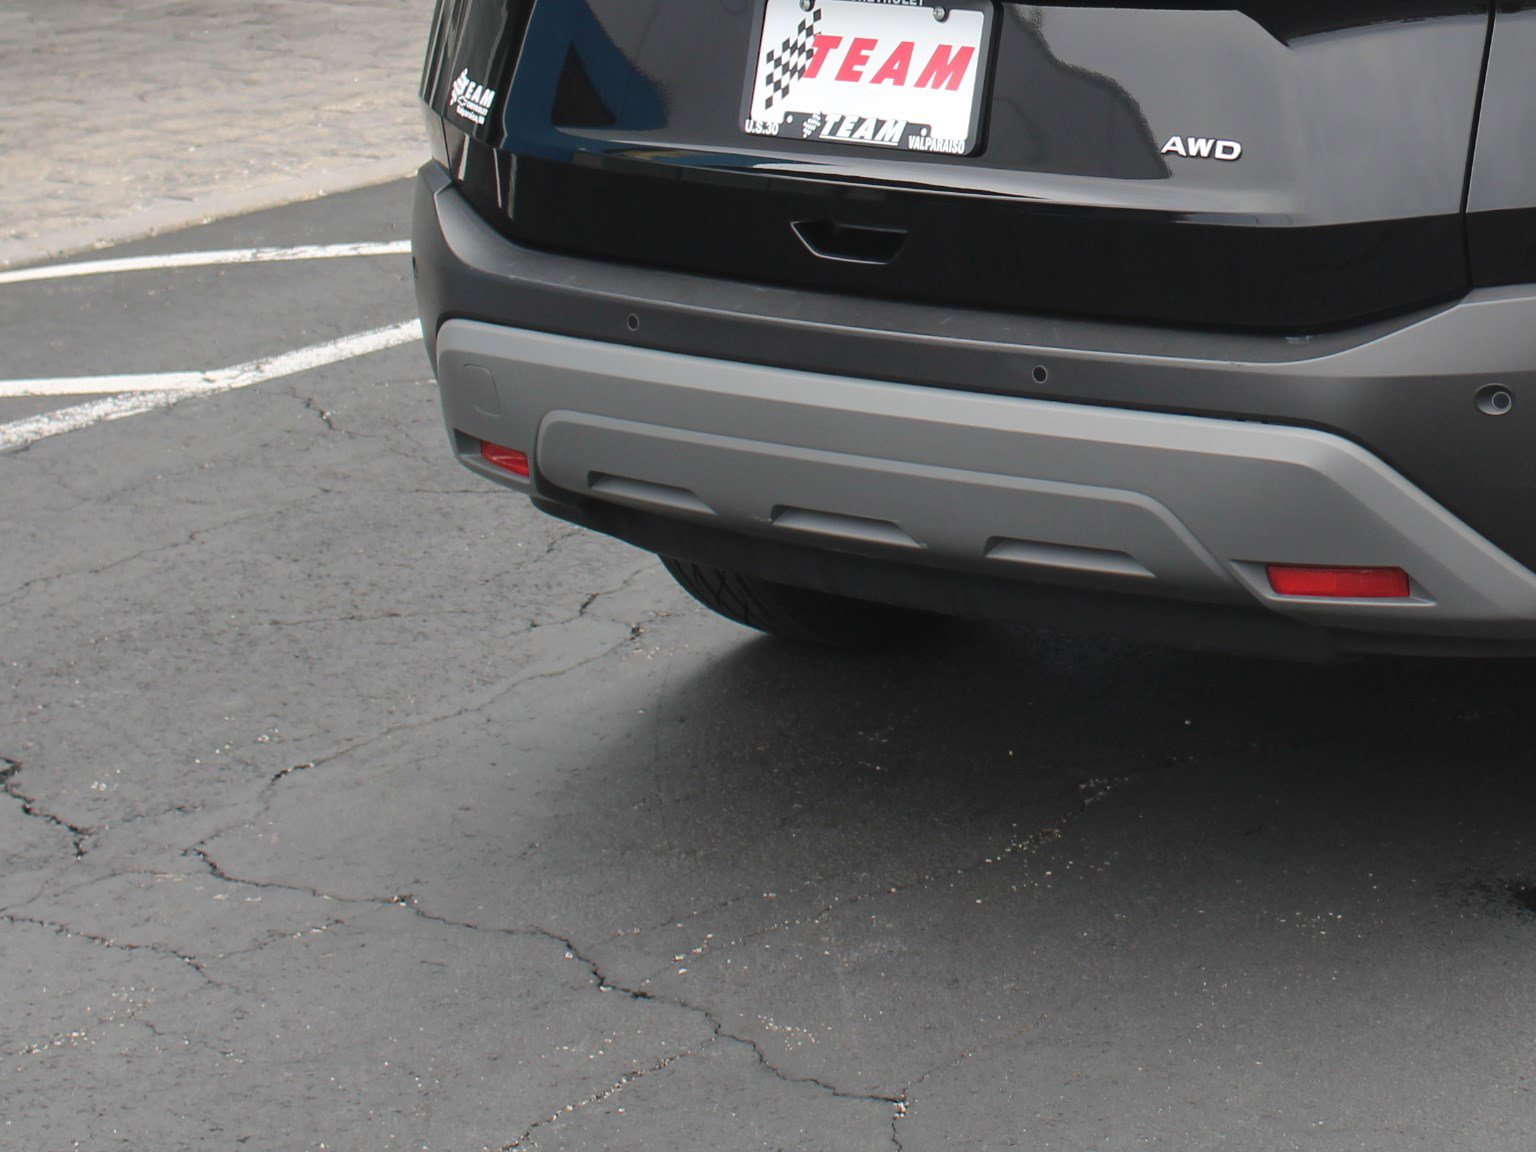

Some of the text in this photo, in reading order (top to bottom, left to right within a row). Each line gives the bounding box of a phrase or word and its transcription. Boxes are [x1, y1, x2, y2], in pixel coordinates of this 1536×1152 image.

[802, 33, 976, 91] TEAM
[818, 113, 908, 144] TEAM
[908, 134, 967, 155] VALPARAISO
[1160, 135, 1242, 161] AWD
